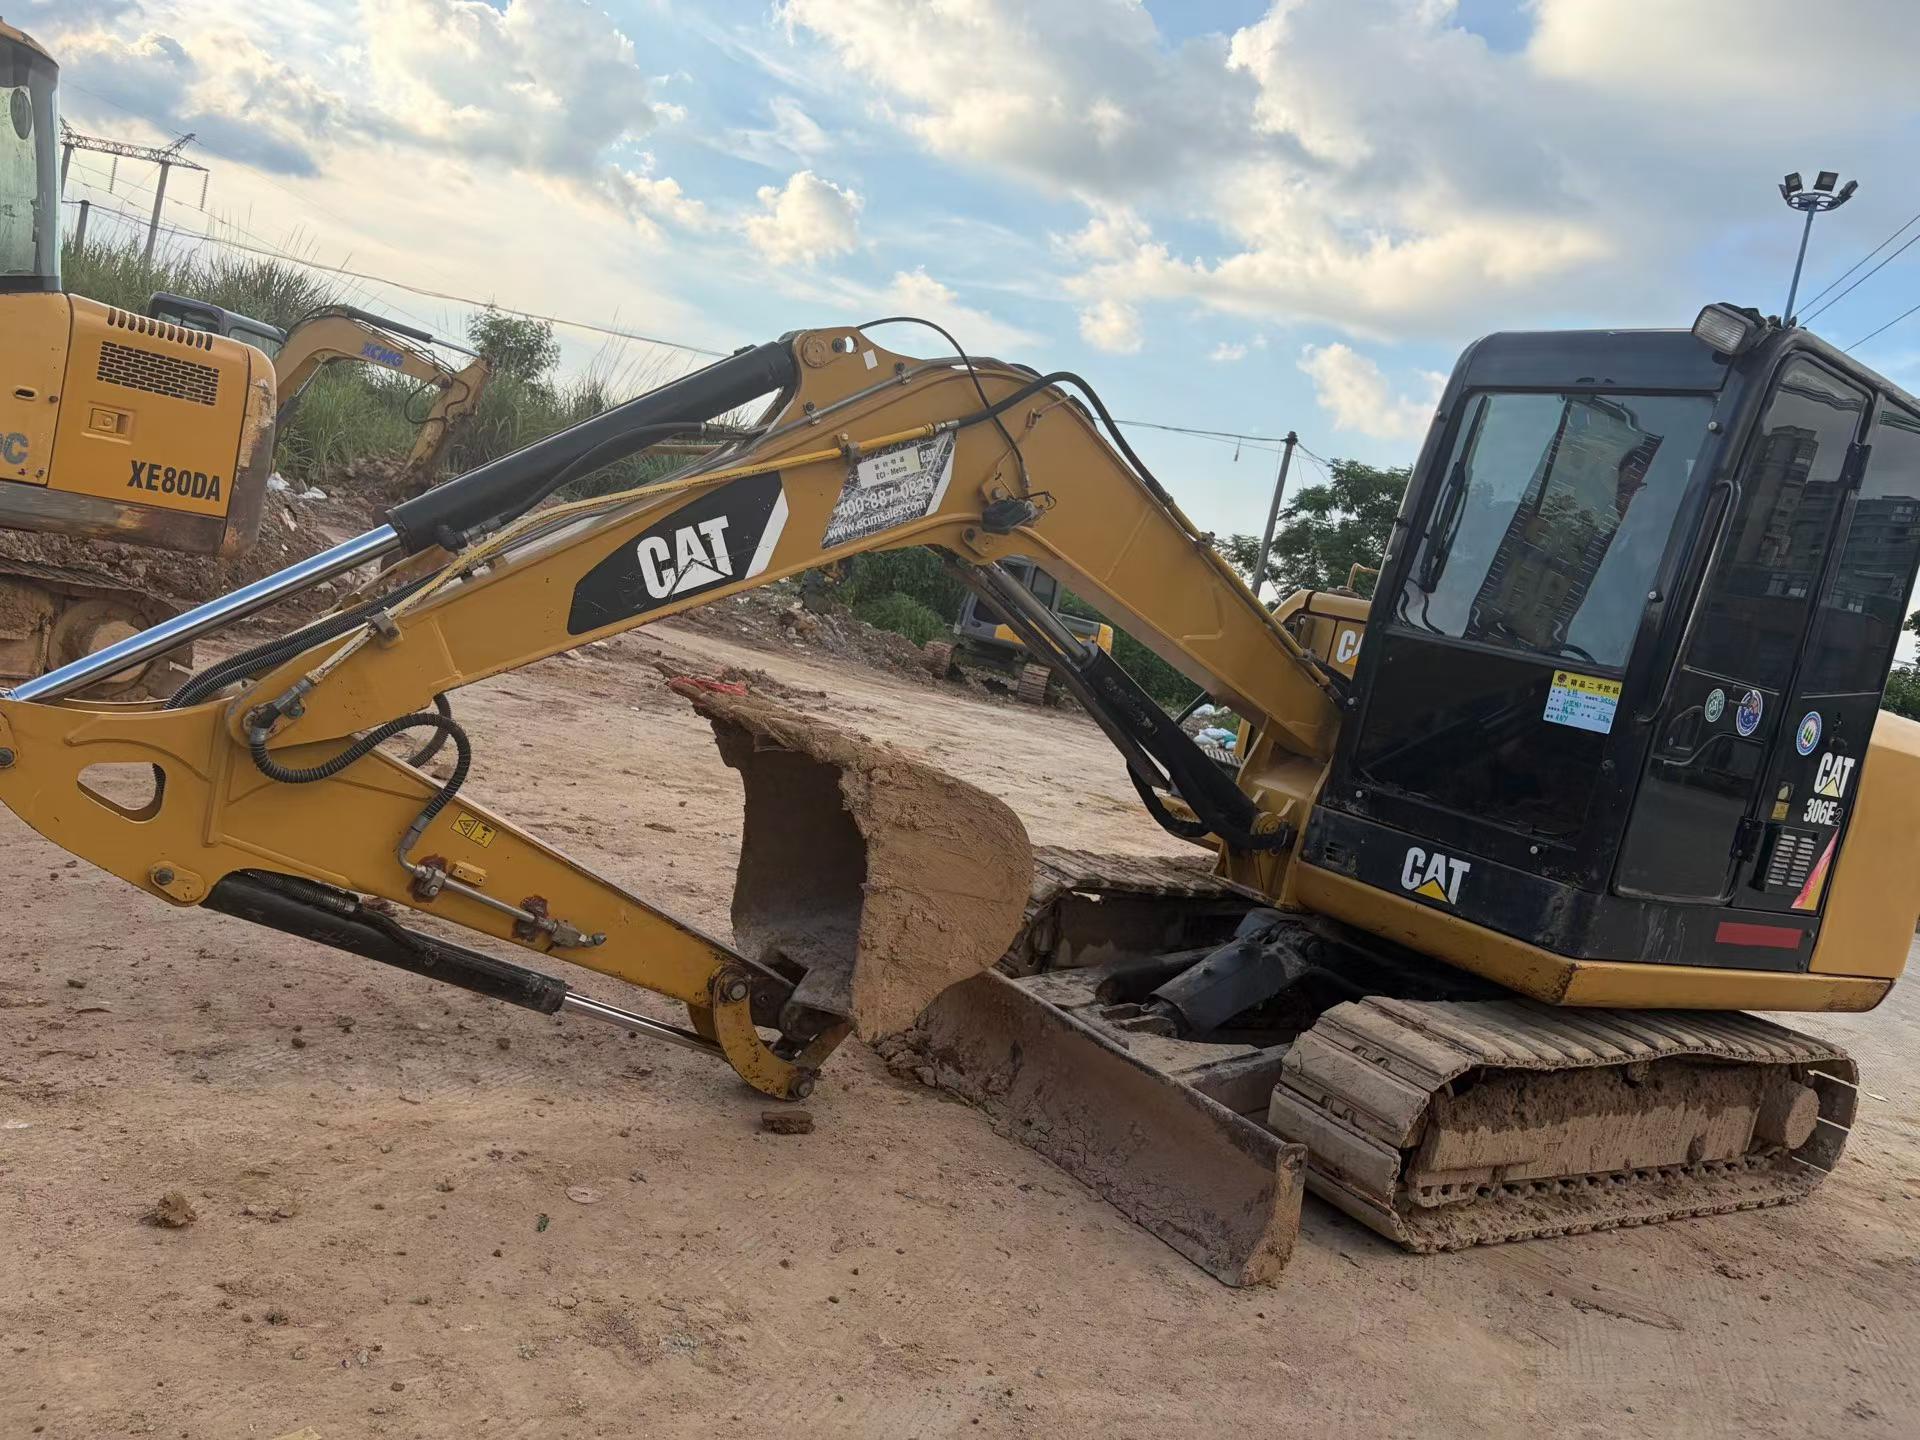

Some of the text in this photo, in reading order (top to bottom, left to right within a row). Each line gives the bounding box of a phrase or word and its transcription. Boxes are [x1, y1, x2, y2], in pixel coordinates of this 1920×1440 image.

[127, 460, 220, 502] XE80DA
[828, 500, 926, 539] www.ecimsales.com
[637, 515, 733, 599] CAT
[1814, 752, 1855, 798] CAT
[1401, 847, 1471, 904] CAT
